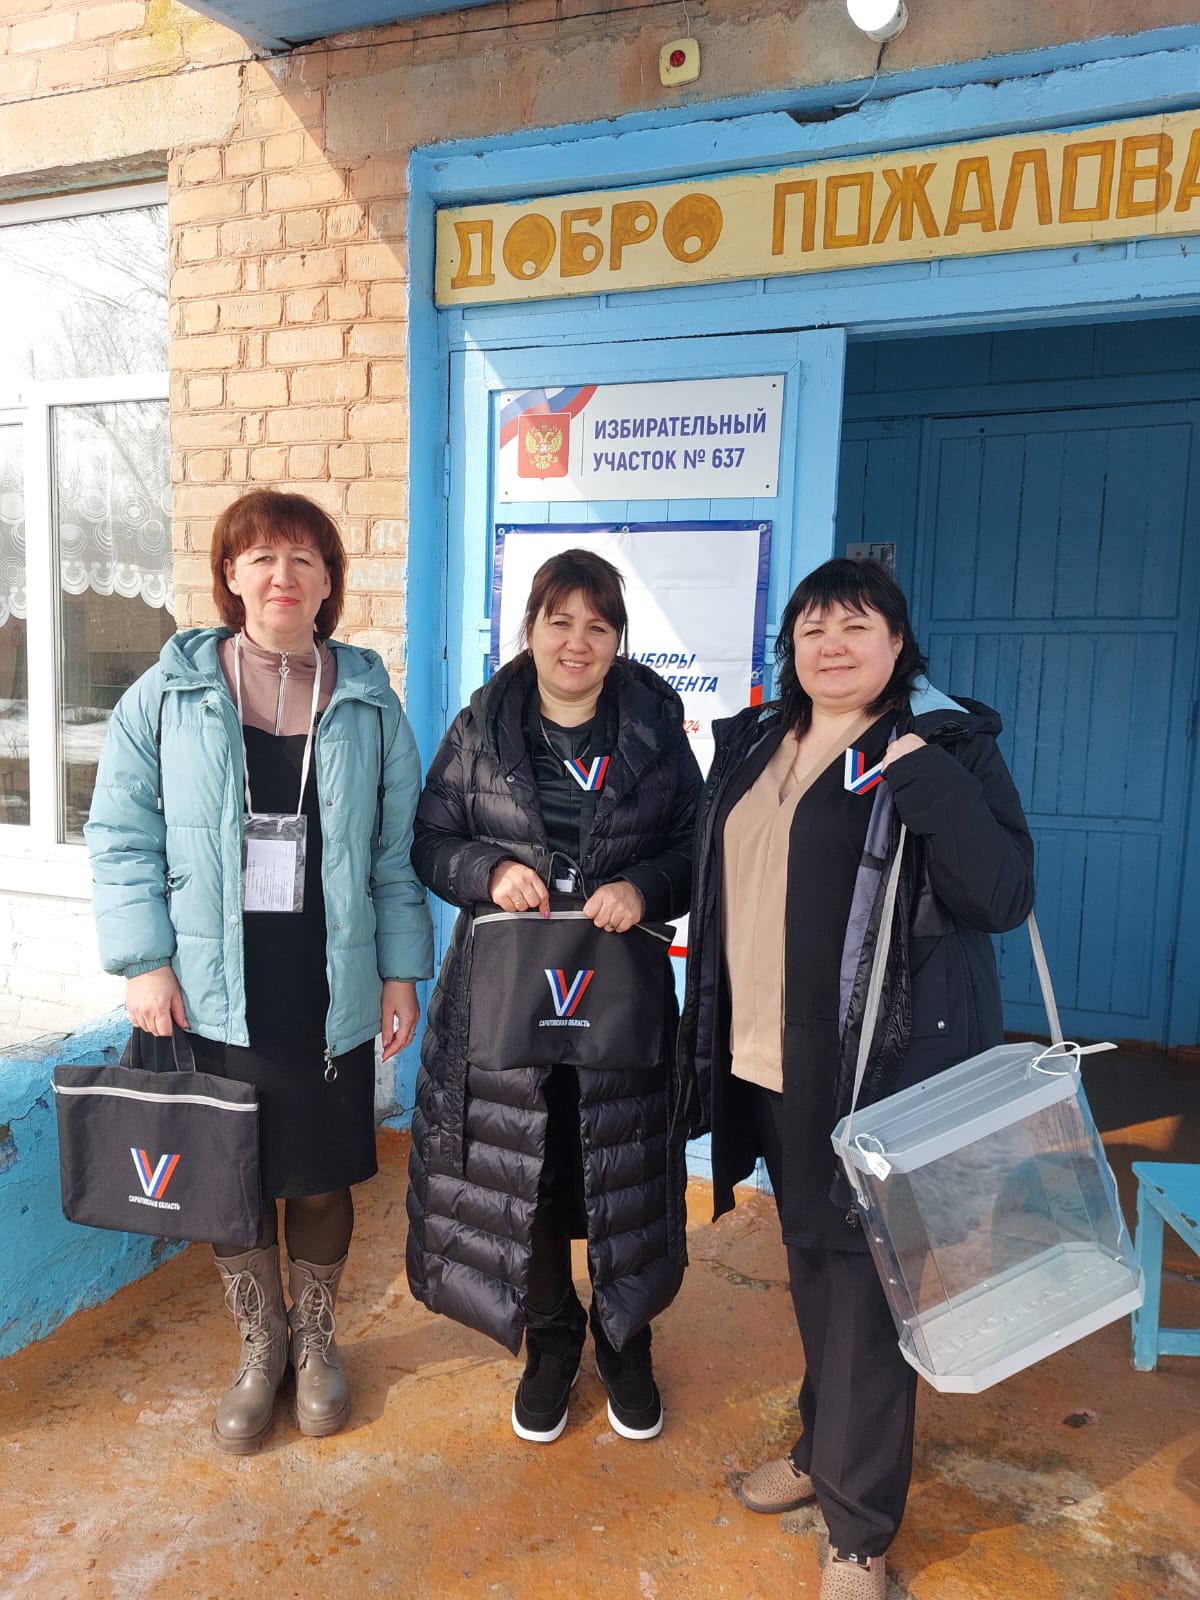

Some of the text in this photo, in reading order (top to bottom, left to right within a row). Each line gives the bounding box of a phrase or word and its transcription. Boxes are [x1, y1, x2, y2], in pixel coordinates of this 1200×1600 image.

[450, 192, 724, 290] ДОБРО
[594, 407, 767, 440] ИЗБИРАТЕЛЬНЫЙ
[593, 447, 746, 472] УЧАСТОК № 637
[630, 652, 697, 669] ЫБОРЫ
